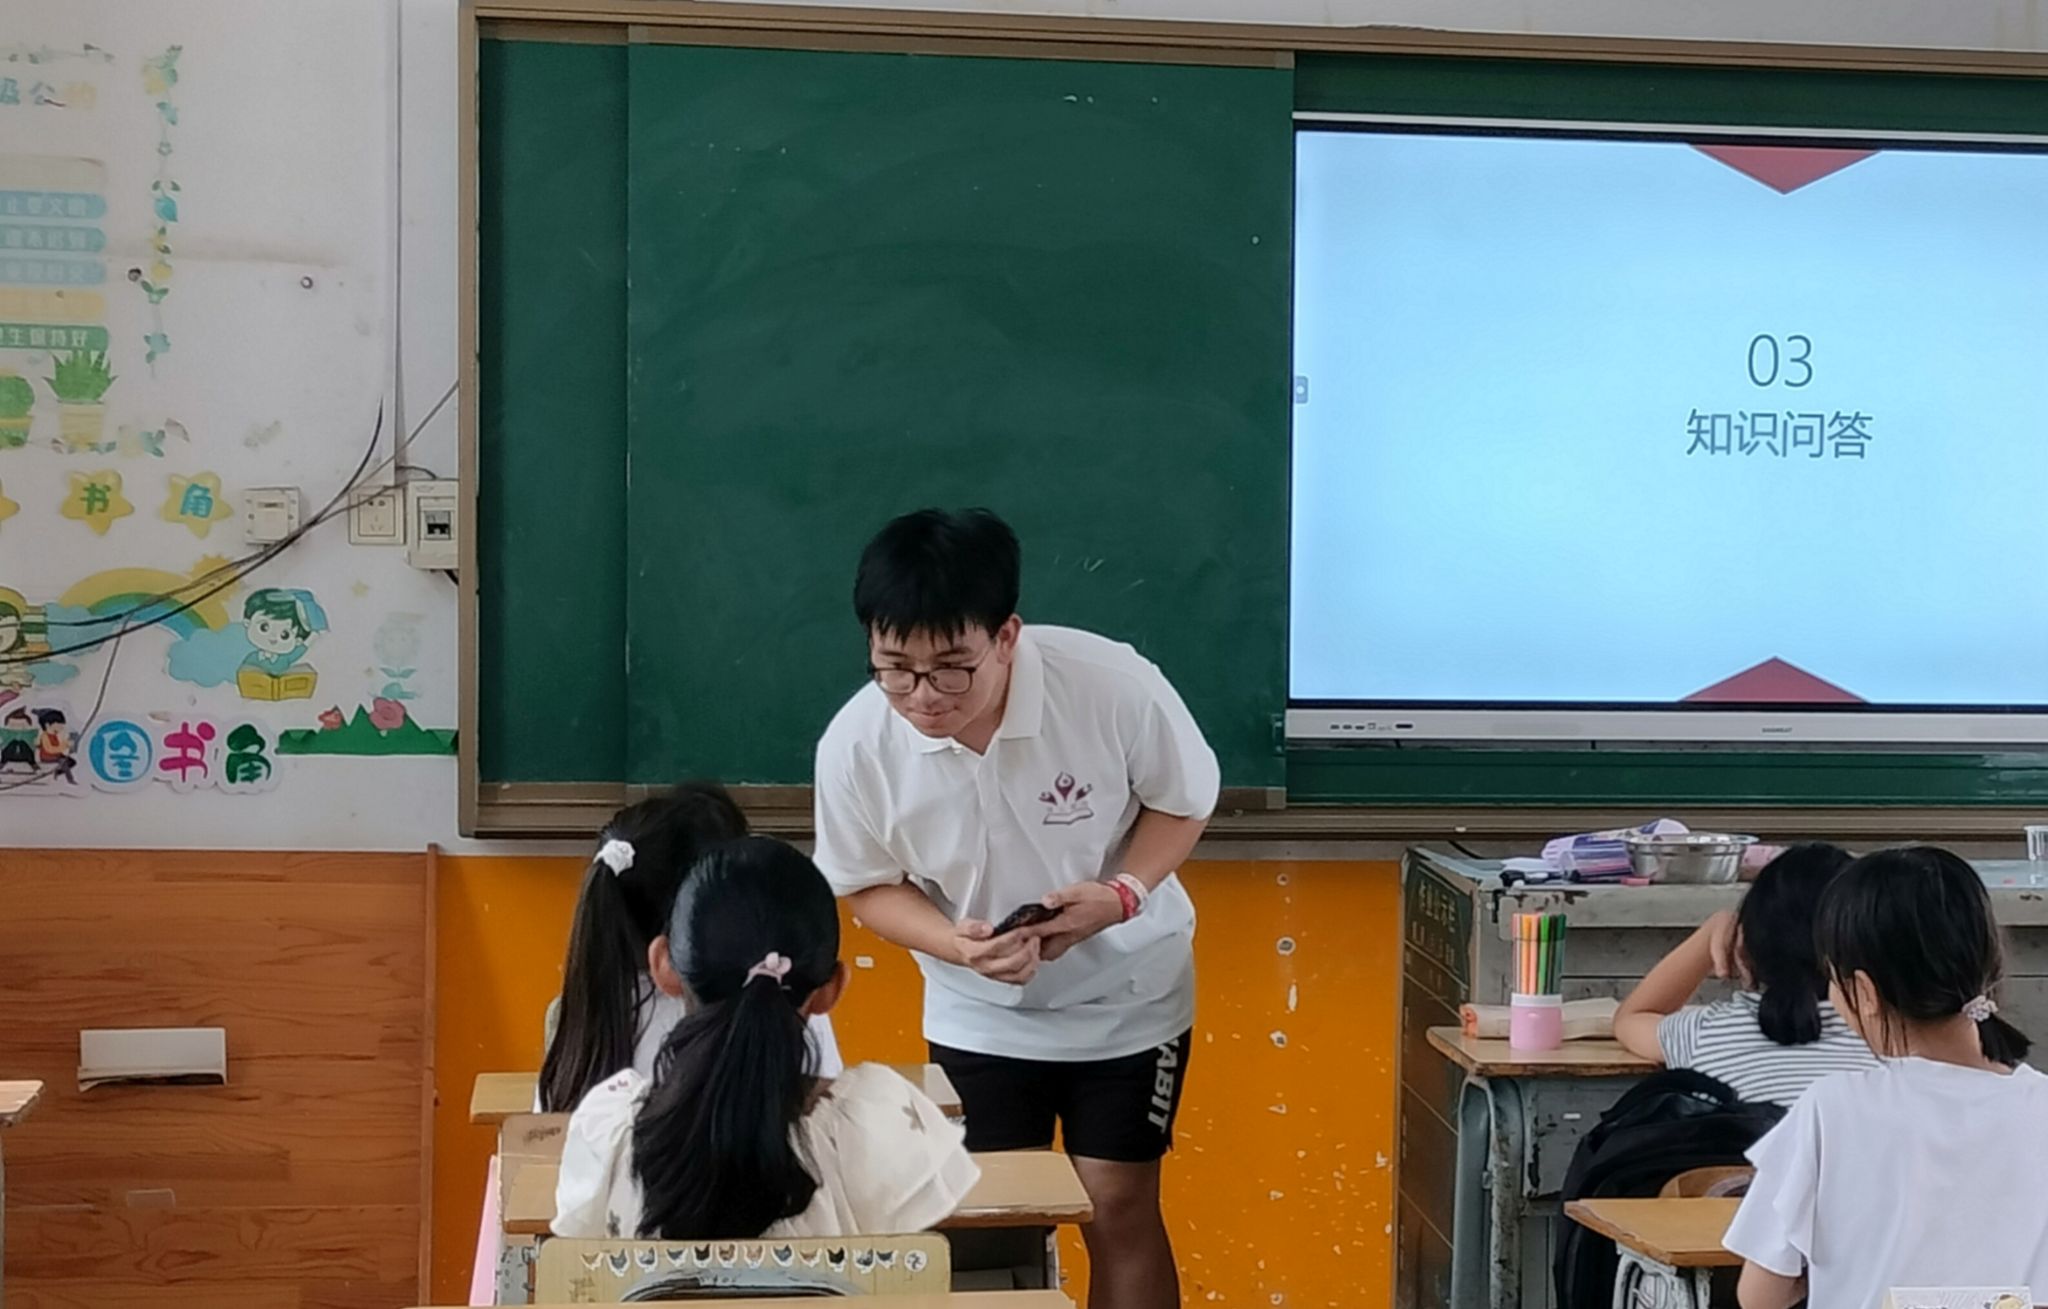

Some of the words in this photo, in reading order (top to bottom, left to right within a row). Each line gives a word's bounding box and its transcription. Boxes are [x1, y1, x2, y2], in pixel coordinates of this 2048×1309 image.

[0, 326, 88, 348] 生保持好
[1748, 333, 1813, 388] 03
[1686, 408, 1874, 459] 知识问答
[88, 719, 273, 785] 图书角
[1148, 1038, 1180, 1135] ABIT
